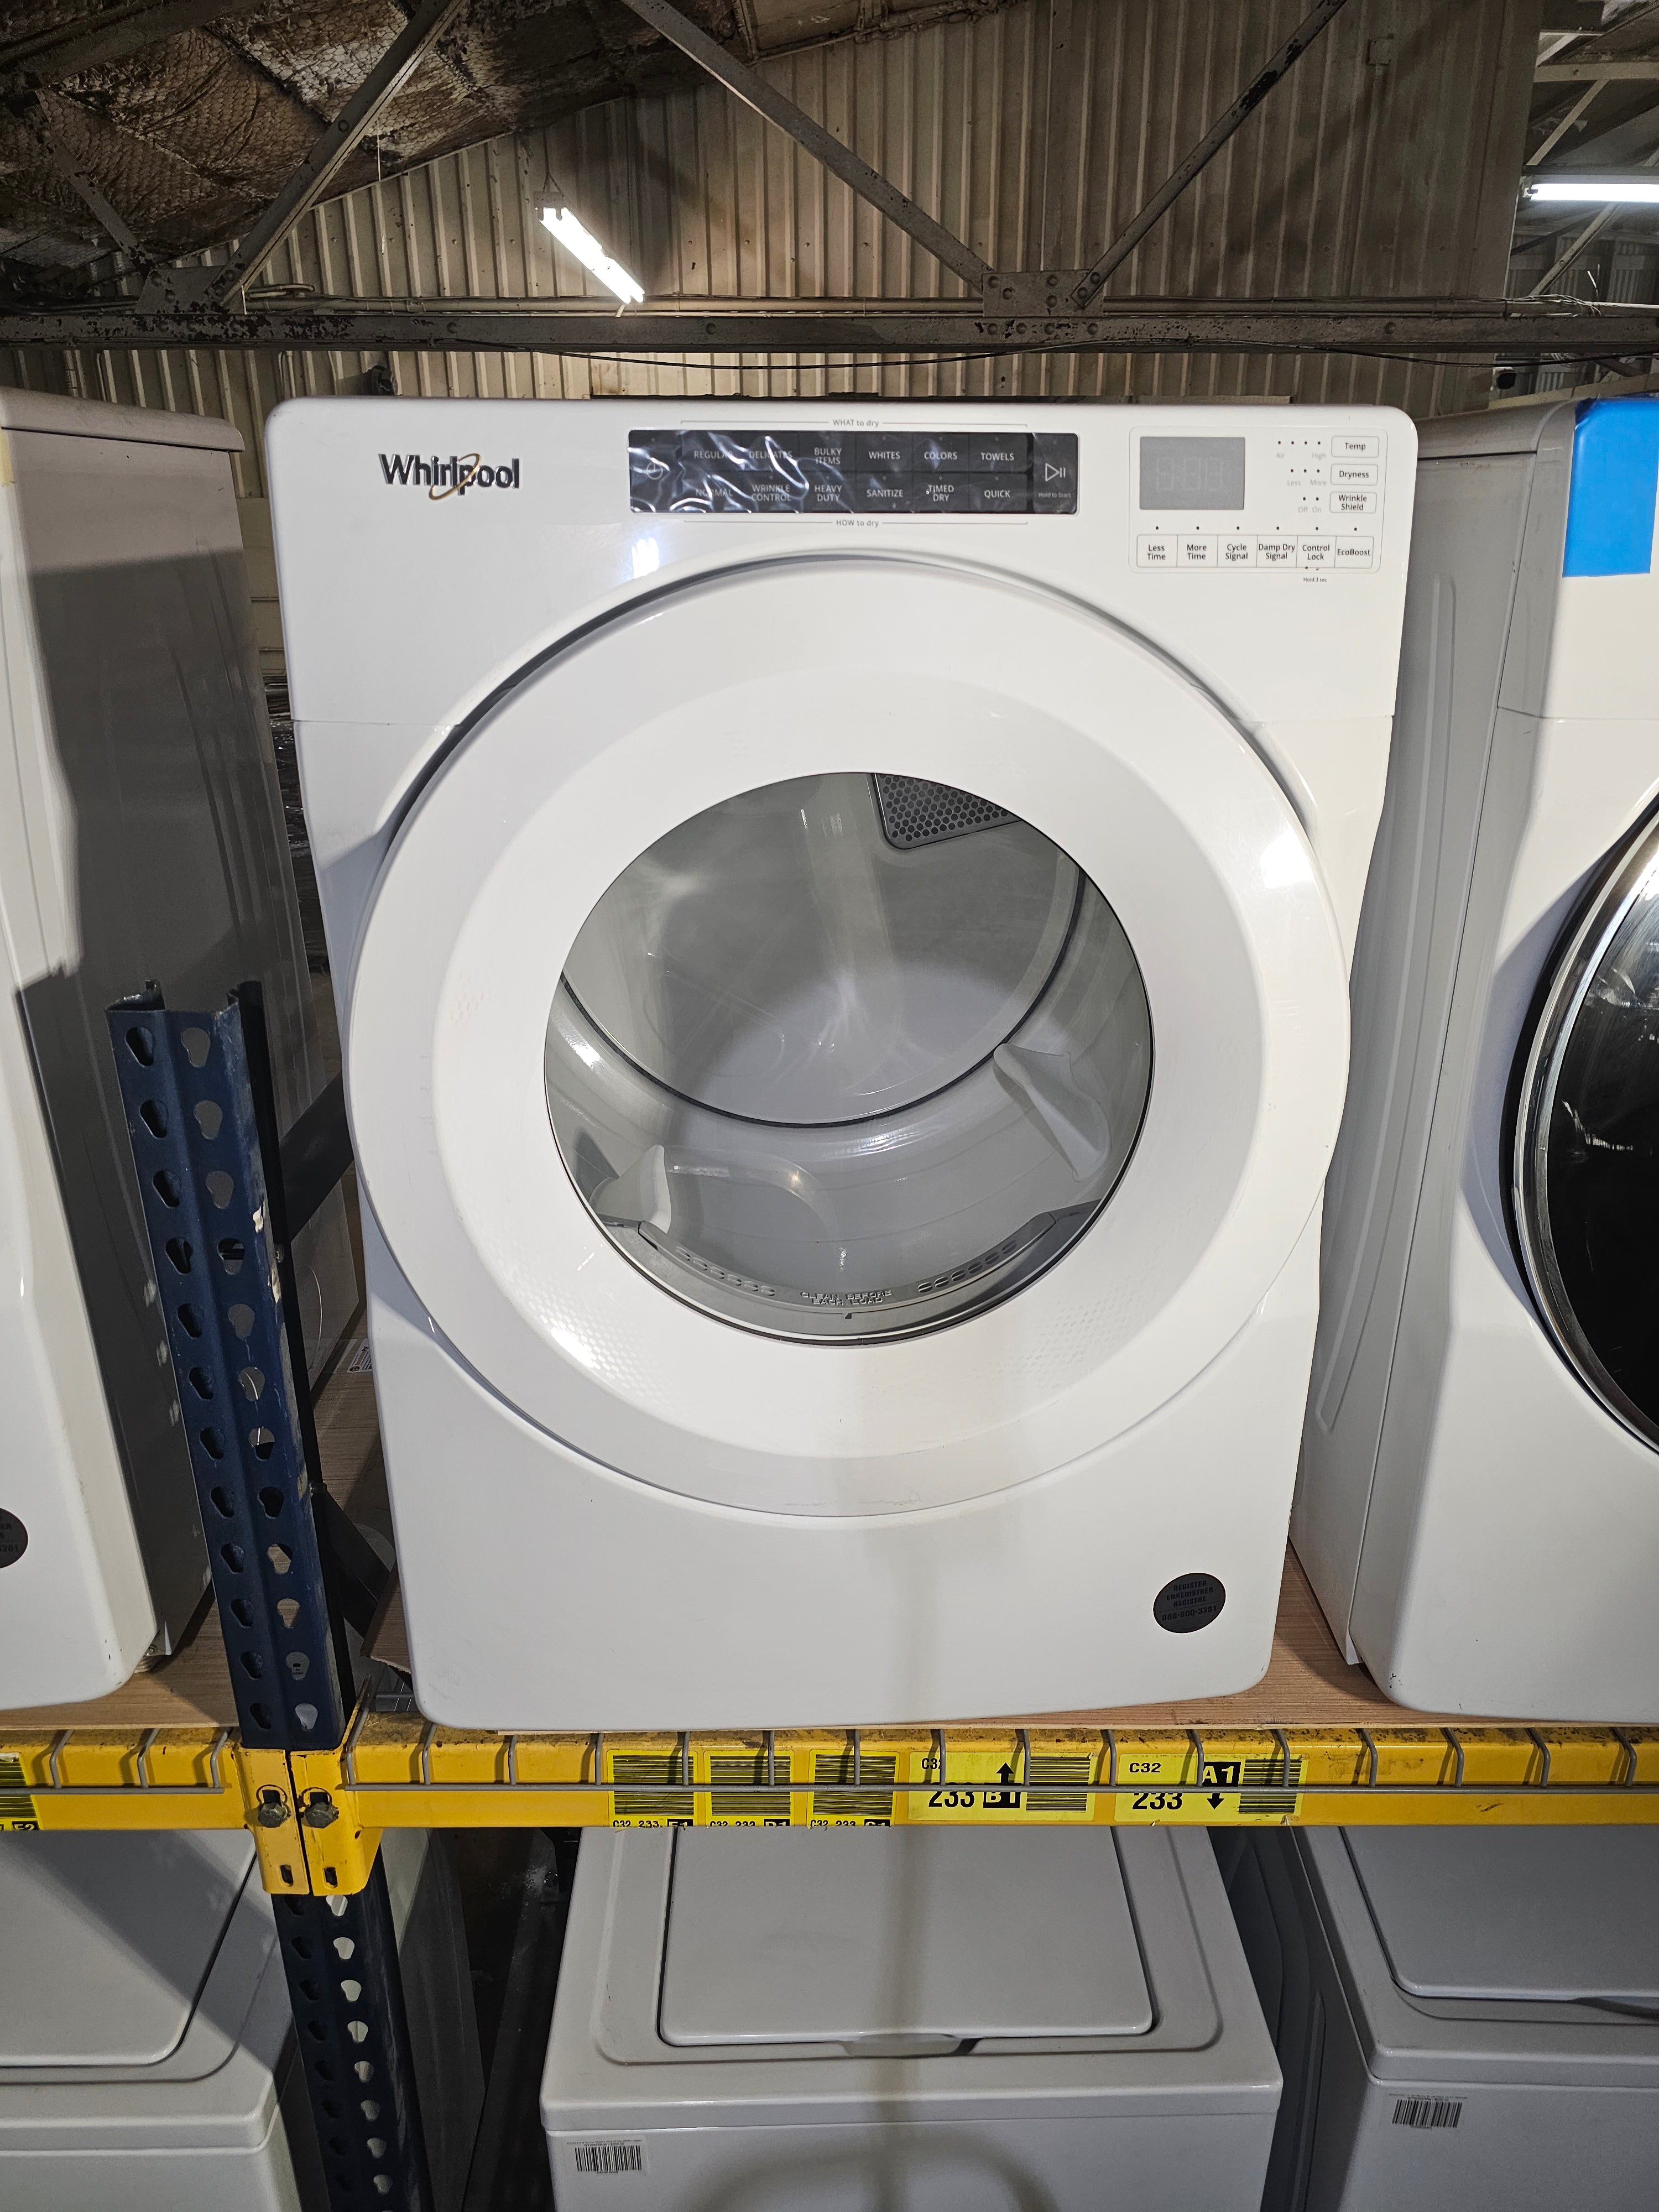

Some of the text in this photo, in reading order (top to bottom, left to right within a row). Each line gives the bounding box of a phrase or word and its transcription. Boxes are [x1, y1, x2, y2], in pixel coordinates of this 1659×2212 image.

[1345, 442, 1366, 451] Temp
[749, 450, 792, 459] DELICATES
[868, 451, 900, 460] WHITES
[924, 452, 957, 460] COLORS
[980, 452, 1014, 461] TOWELS
[1312, 452, 1326, 461] High
[378, 453, 520, 495] Whirlpool
[1339, 471, 1369, 480] Dryness
[695, 488, 733, 497] NORMAL
[752, 484, 790, 493] WRINKLE
[928, 484, 954, 493] TIMED
[752, 493, 791, 502] CONTROL
[867, 489, 903, 498] SANITIZE
[984, 489, 1010, 498] QUICK
[1338, 494, 1368, 502] Wrinkle
[1227, 543, 1247, 552] Cycle
[1258, 544, 1296, 553] Damp Dry
[1225, 552, 1248, 561] Signal
[1266, 552, 1287, 561] Signal
[801, 1290, 892, 1300] CLEAN BEFORE
[1173, 1580, 1207, 1592] REGISTER
[1129, 1762, 1161, 1773] C32
[1202, 1766, 1235, 1783] A1
[928, 1782, 975, 1808] 233
[1132, 1792, 1183, 1810] 233
